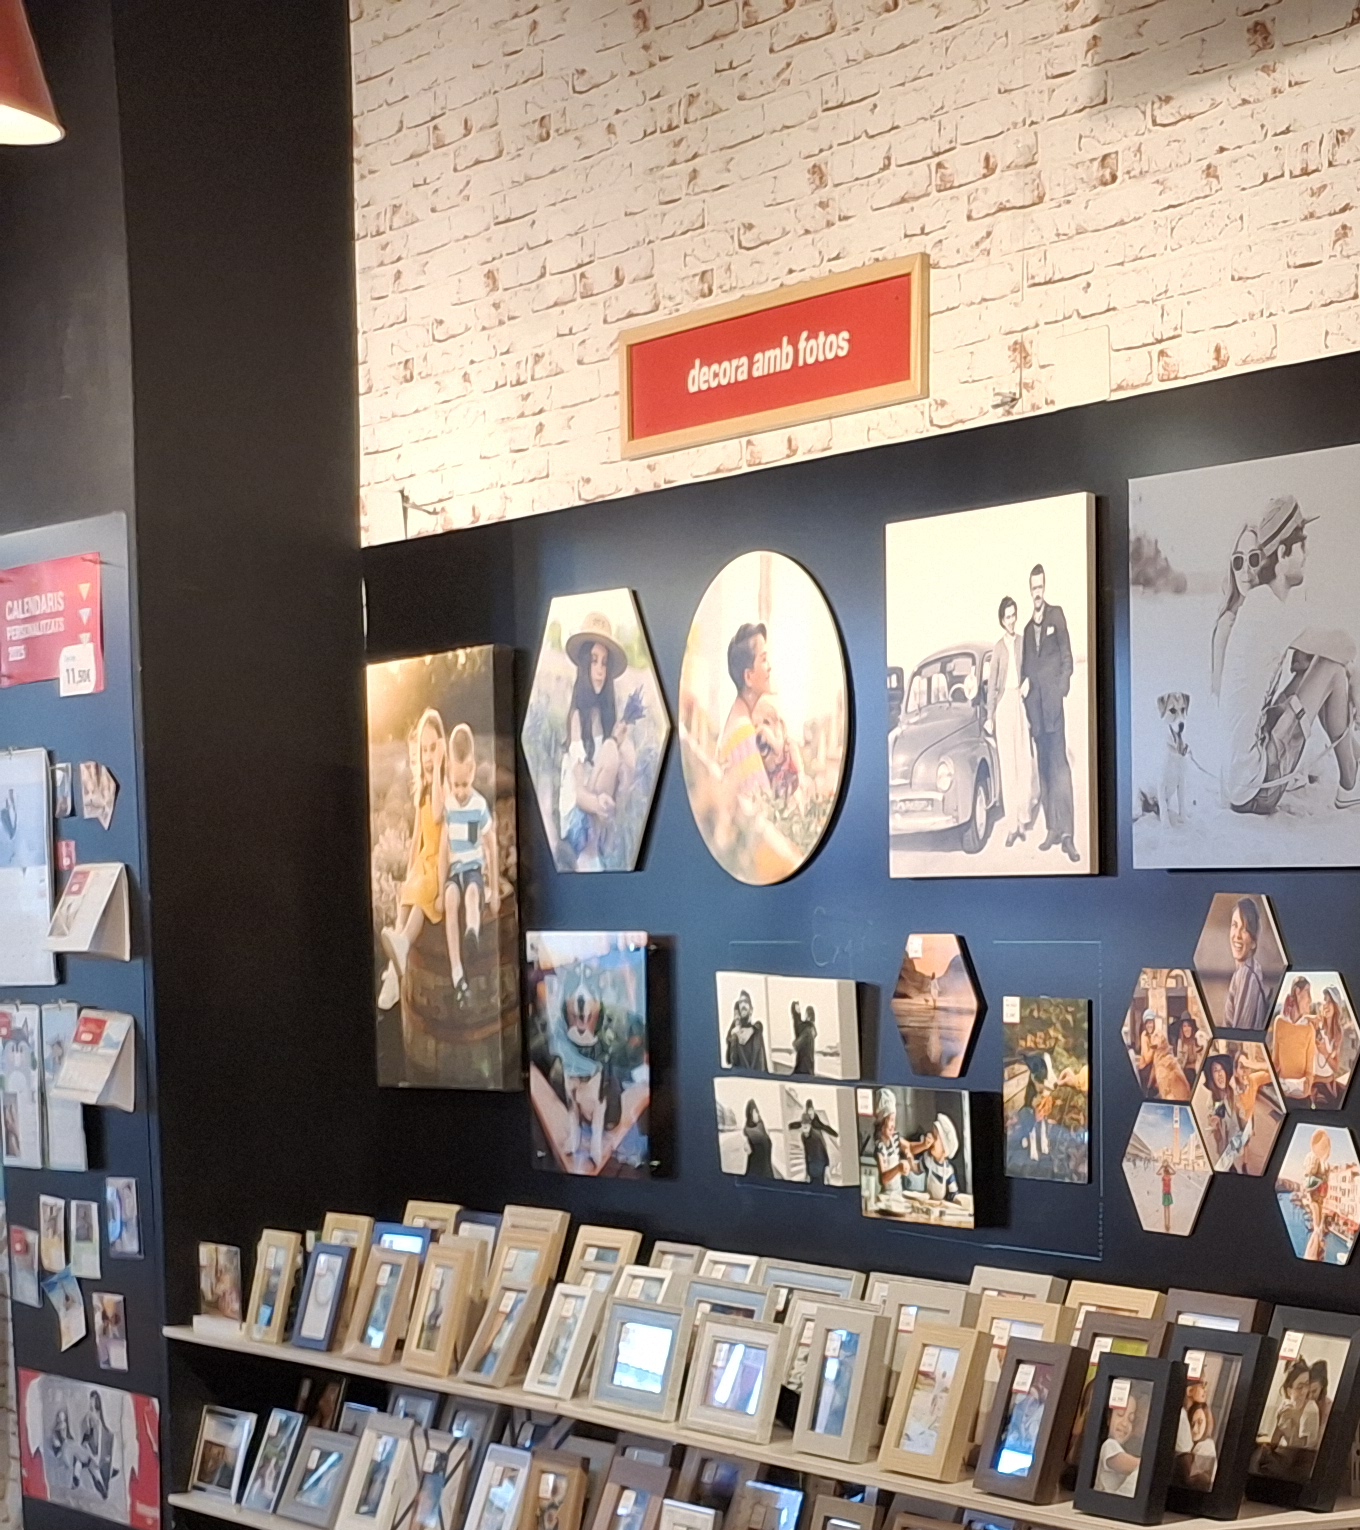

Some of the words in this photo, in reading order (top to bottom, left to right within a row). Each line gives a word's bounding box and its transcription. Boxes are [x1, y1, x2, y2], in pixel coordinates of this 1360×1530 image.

[687, 358, 749, 393] decora
[751, 336, 794, 379] amb
[797, 330, 850, 367] fotos
[6, 591, 64, 620] CALENDARIS
